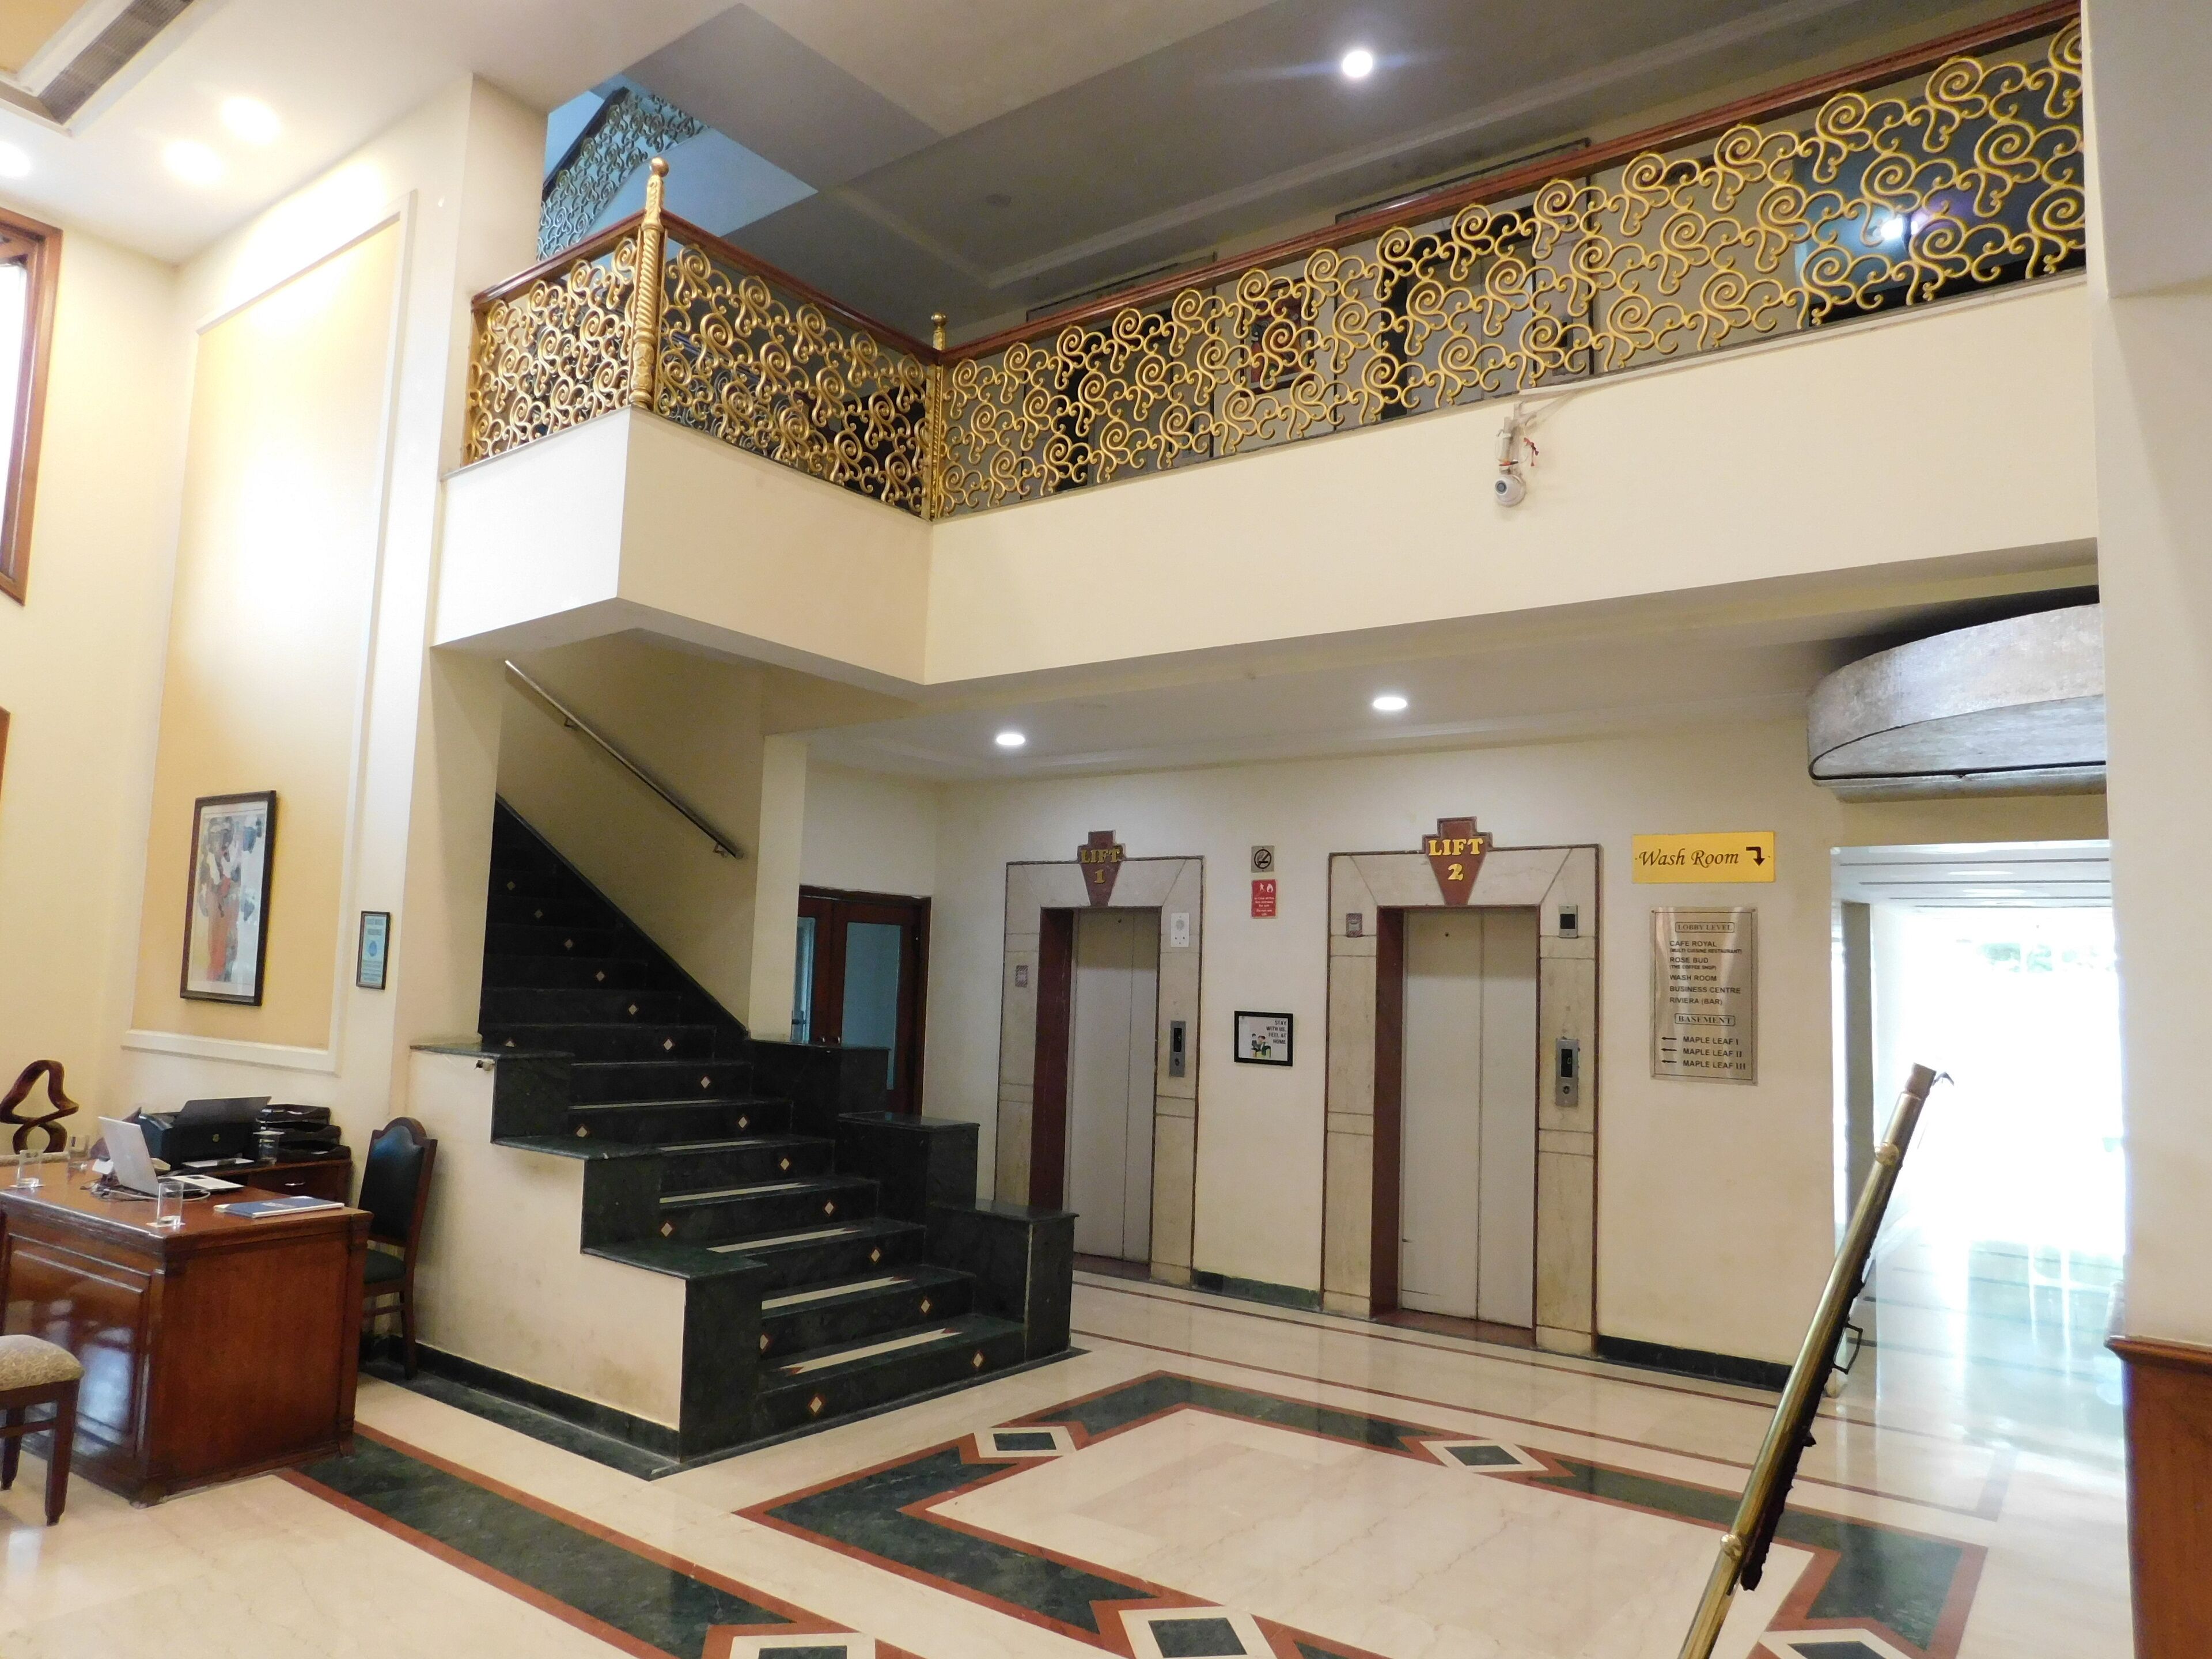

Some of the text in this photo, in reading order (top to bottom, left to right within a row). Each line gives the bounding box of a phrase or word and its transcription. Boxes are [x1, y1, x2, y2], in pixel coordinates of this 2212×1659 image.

[1428, 838, 1484, 856] LIFT
[1081, 849, 1120, 863] LIFT
[1639, 848, 1739, 868] Wash Room
[1094, 869, 1105, 884] 1
[1448, 863, 1464, 881] 2
[1678, 1016, 1731, 1024] BASEMENT
[1683, 1048, 1710, 1056] MAPLE
[1683, 1060, 1710, 1068] MAPLE
